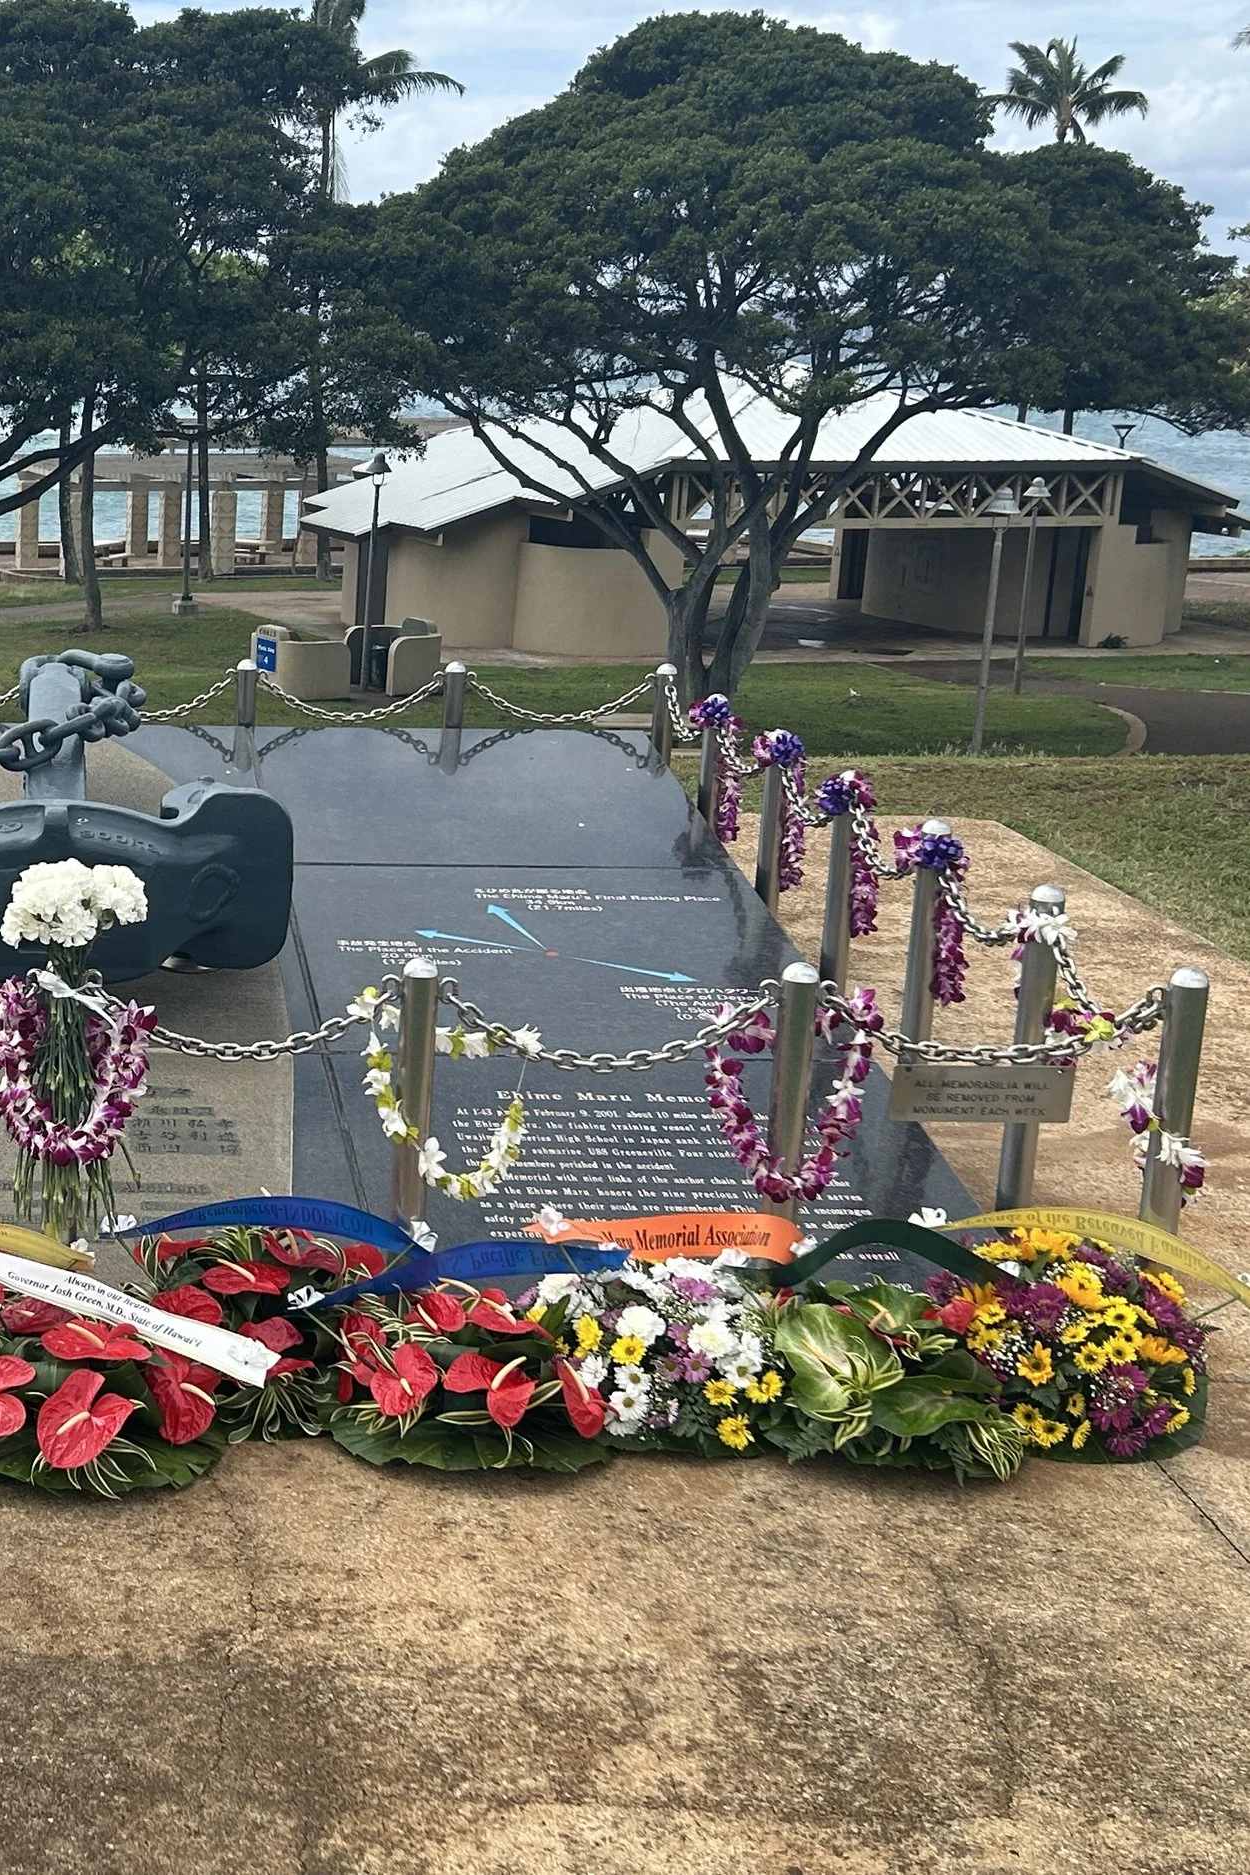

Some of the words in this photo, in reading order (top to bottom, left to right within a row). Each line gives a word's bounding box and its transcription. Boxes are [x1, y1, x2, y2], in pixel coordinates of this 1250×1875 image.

[453, 947, 513, 955] Accident
[914, 1079, 934, 1089] ALL
[941, 1079, 1019, 1090] MEMORABILIA
[1022, 1080, 1050, 1091] WILL
[495, 1090, 564, 1101] Ehime
[576, 1091, 632, 1102] Maru
[644, 1093, 712, 1103] Memo
[926, 1092, 941, 1101] BE
[947, 1092, 999, 1103] REMOVED
[1004, 1093, 1036, 1103] FROM
[456, 1107, 469, 1116] At
[533, 1108, 576, 1118] February
[625, 1110, 654, 1119] about
[655, 1111, 670, 1119] 10
[672, 1111, 698, 1120] miles
[700, 1112, 728, 1121] south
[912, 1105, 975, 1115] MONUMENT
[979, 1106, 1009, 1116] EACH
[1014, 1106, 1046, 1117] WEEK
[452, 1120, 470, 1128] the
[475, 1120, 505, 1129] Ehim
[546, 1122, 564, 1130] the
[568, 1122, 607, 1131] fishing
[611, 1123, 658, 1133] training
[662, 1123, 696, 1132] vessel
[699, 1124, 712, 1132] of
[456, 1132, 492, 1142] Uwaji
[555, 1134, 582, 1143] High
[586, 1134, 619, 1143] School
[623, 1135, 635, 1143] in
[640, 1136, 671, 1145] Japan
[675, 1136, 702, 1145] sank
[705, 1137, 732, 1145] after
[462, 1145, 478, 1154] the
[588, 1147, 609, 1156] USS
[679, 1149, 705, 1158] Four
[708, 1150, 739, 1158] stude
[509, 1160, 556, 1168] wmembers
[559, 1160, 598, 1170] perished
[602, 1161, 613, 1169] in
[616, 1162, 632, 1170] the
[636, 1162, 678, 1171] accident.
[505, 1173, 552, 1182] Memorial
[556, 1173, 579, 1183] with
[582, 1174, 603, 1183] nine
[607, 1174, 633, 1183] links
[637, 1175, 647, 1184] of
[651, 1176, 669, 1184] the
[673, 1176, 705, 1185] anchor
[710, 1177, 737, 1186] chain
[741, 1178, 756, 1186] an
[504, 1186, 522, 1195] the
[525, 1186, 559, 1196] Ehime
[597, 1188, 634, 1197] honors
[638, 1189, 657, 1198] the
[661, 1189, 687, 1198] nine
[691, 1190, 739, 1200] precious
[826, 1193, 864, 1201] serves
[496, 1201, 505, 1209] a
[508, 1200, 537, 1210] place
[541, 1201, 574, 1210] where
[578, 1201, 606, 1211] their
[610, 1202, 639, 1212] souls
[642, 1203, 661, 1212] are
[730, 1204, 758, 1213] This
[813, 1208, 873, 1217] encourages
[484, 1215, 516, 1225] safety
[519, 1216, 537, 1224] and
[490, 1230, 543, 1239] experien
[634, 1224, 700, 1251] Memorial
[858, 1251, 901, 1261] overall
[63, 1275, 96, 1292] Always
[97, 1285, 106, 1296] in
[106, 1291, 123, 1302] our
[124, 1297, 151, 1313] hearts
[7, 1271, 50, 1291] Governor
[50, 1284, 73, 1298] Josh
[74, 1290, 104, 1310] Green,
[105, 1302, 127, 1320] M.D.,
[128, 1312, 151, 1327] State
[151, 1321, 165, 1333] of
